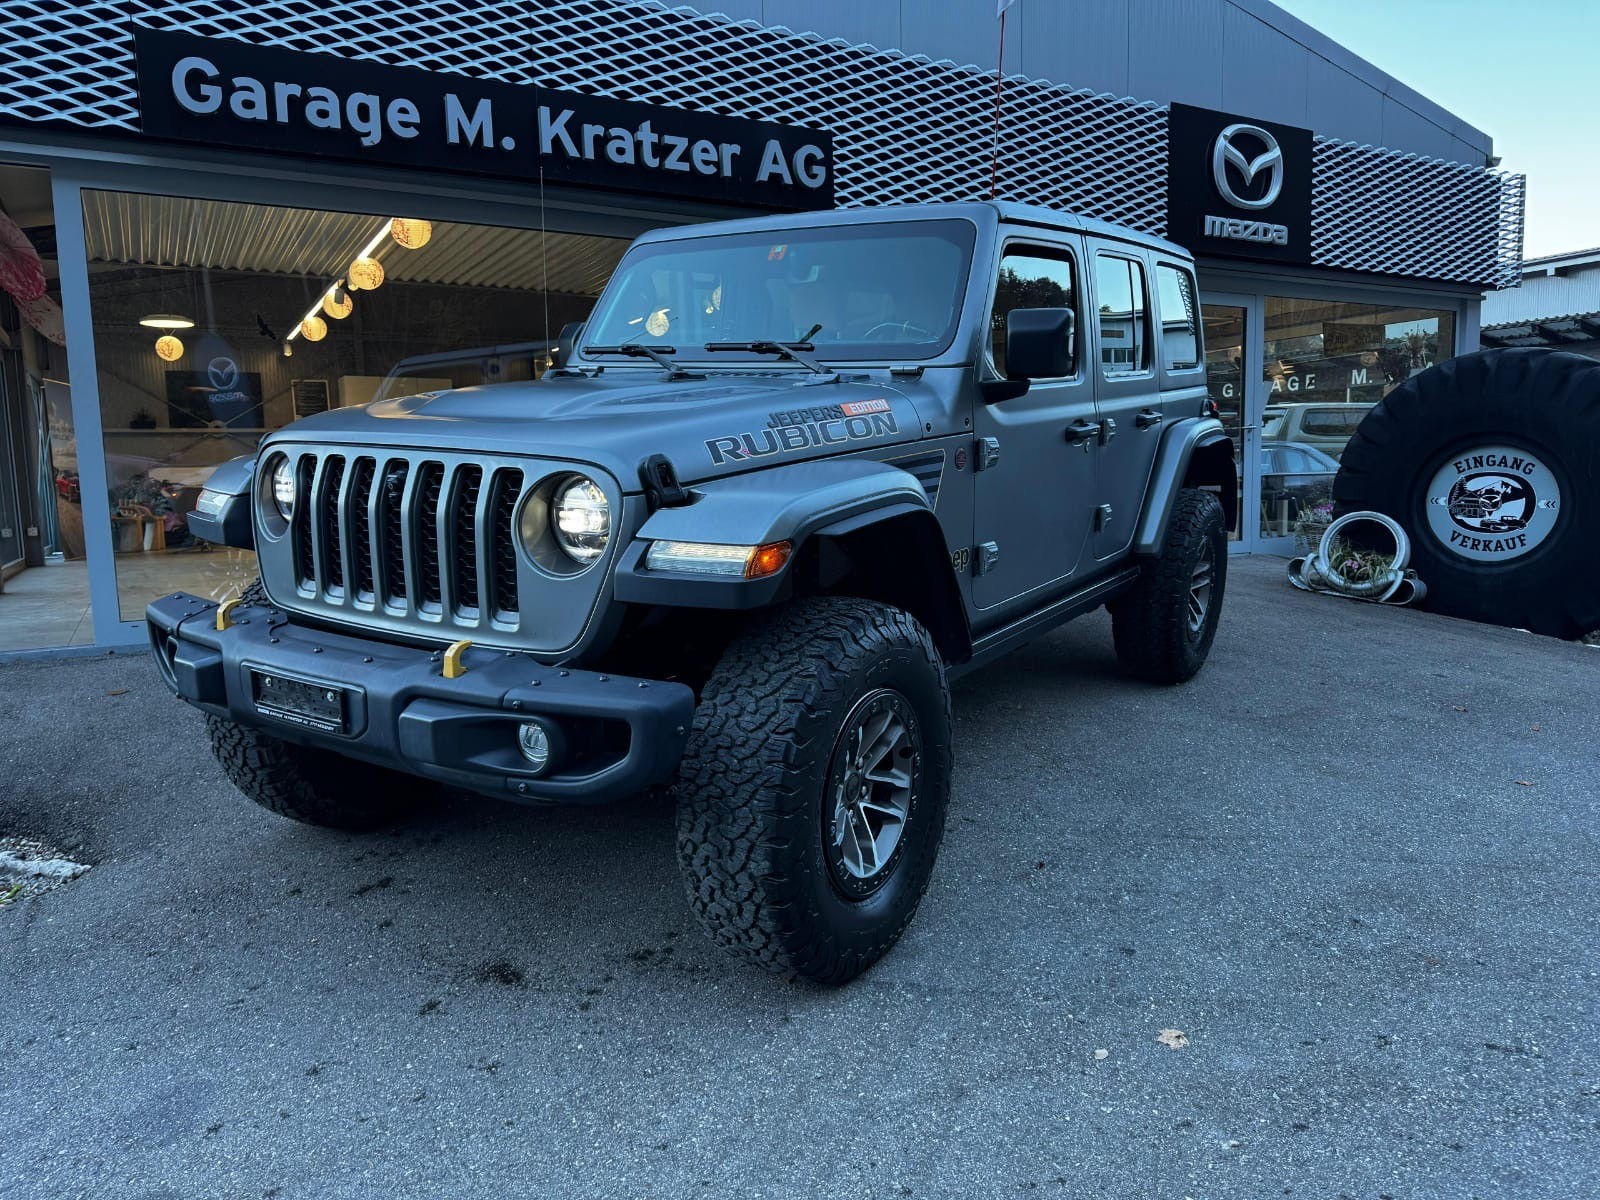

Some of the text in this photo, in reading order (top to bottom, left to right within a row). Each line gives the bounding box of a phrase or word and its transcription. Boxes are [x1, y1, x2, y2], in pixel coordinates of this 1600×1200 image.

[171, 56, 827, 188] Garage M. Kratzer AG
[1204, 214, 1289, 246] mazda
[1222, 373, 1317, 398] GAGE
[766, 398, 890, 429] JEEPERS EDITION
[703, 412, 900, 467] RUBICON
[1453, 454, 1536, 476] EINGANG
[1448, 529, 1529, 553] VERKAUF
[950, 547, 970, 573] ep
